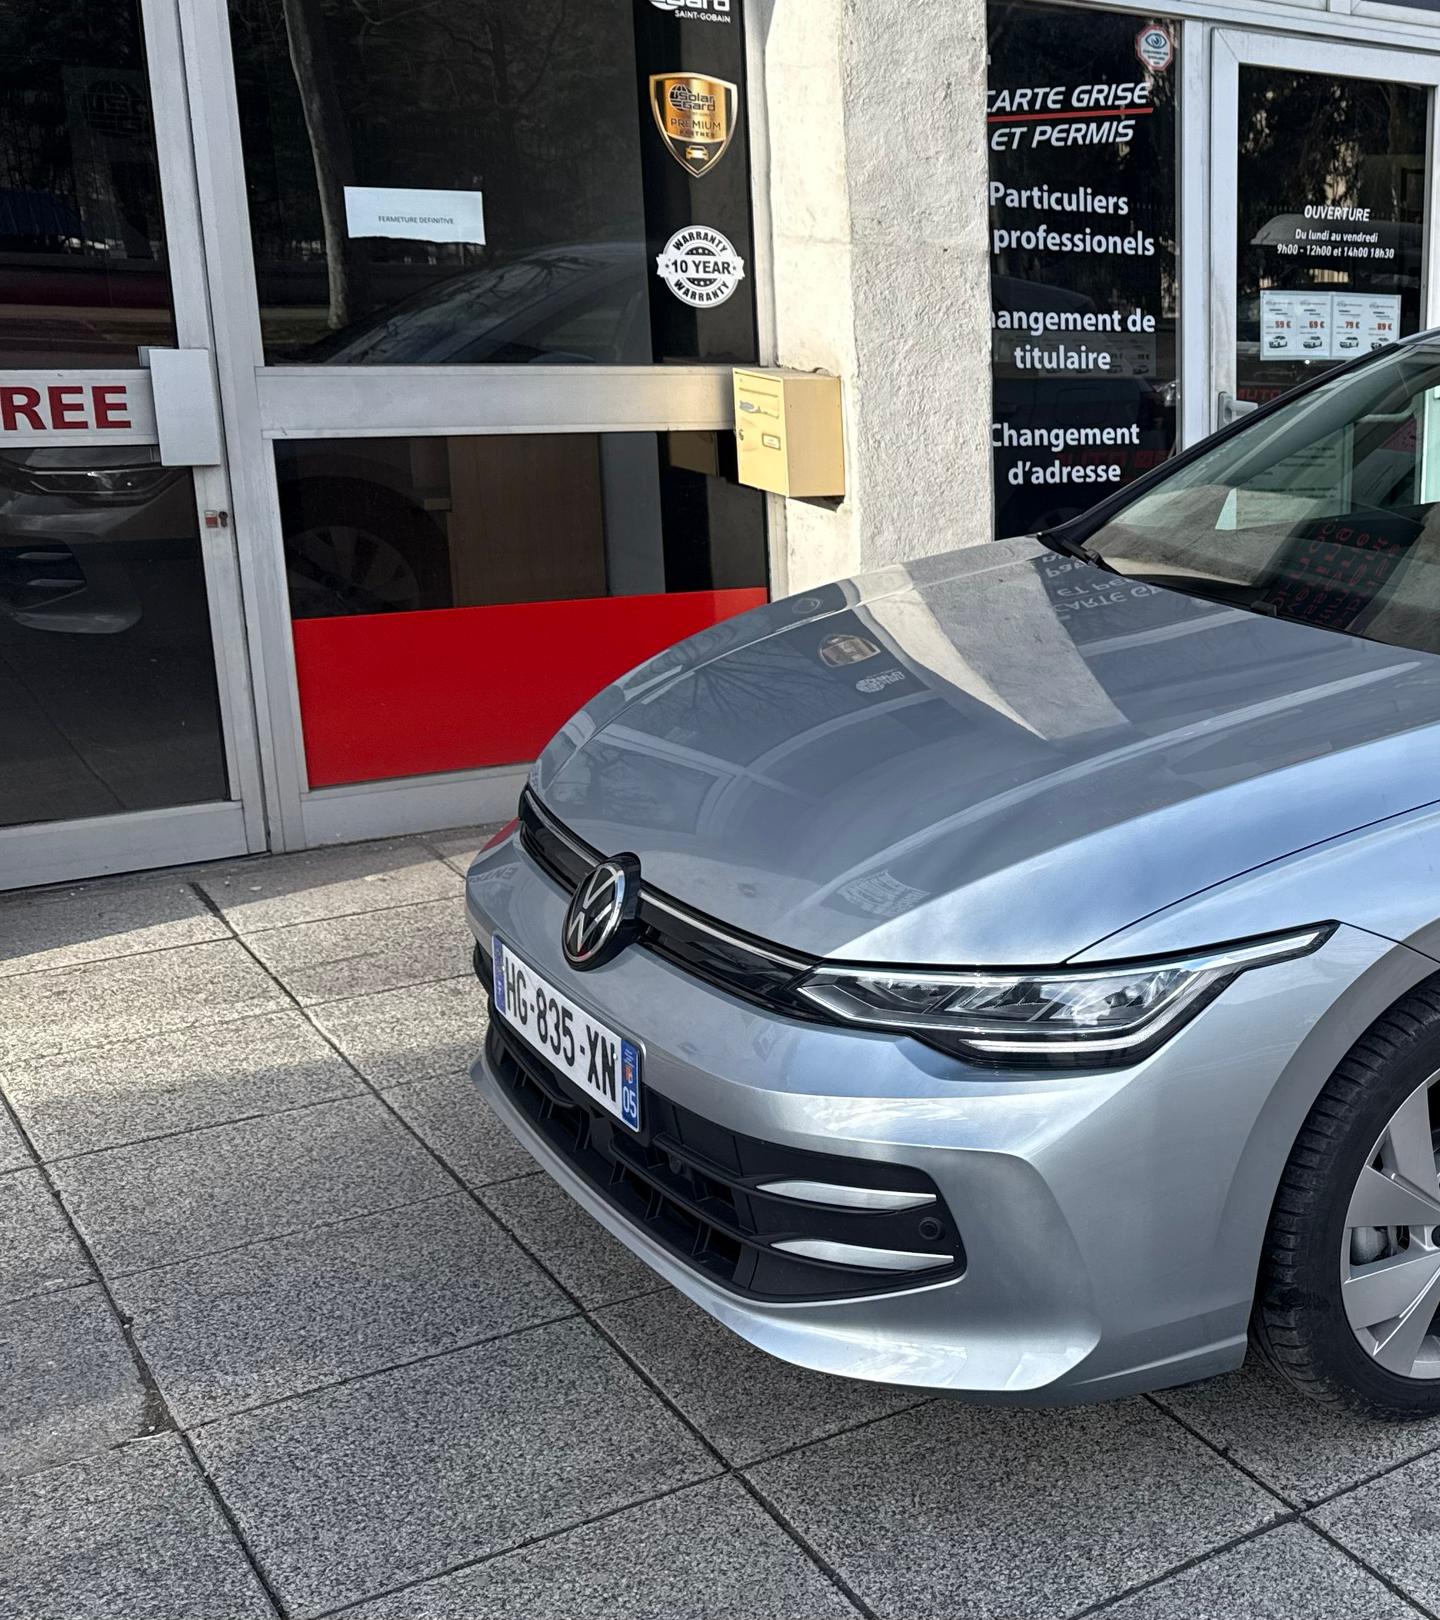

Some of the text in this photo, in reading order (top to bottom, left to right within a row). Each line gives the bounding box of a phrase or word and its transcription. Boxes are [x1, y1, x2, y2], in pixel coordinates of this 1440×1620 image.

[674, 9, 731, 23] SAINT-GOBAIN
[678, 92, 715, 104] Solar
[1070, 82, 1151, 109] GRISE
[670, 118, 721, 131] PREMIUM
[990, 119, 1136, 151] ET PERMIS
[989, 180, 1129, 216] Particuliers
[377, 215, 454, 225] FERMETURE DEFINITIVE
[1304, 204, 1371, 222] OUVERTURE
[672, 231, 728, 253] WARRANTY
[993, 224, 1156, 256] professionels
[1295, 228, 1379, 243] Du lundi au vendredi
[1276, 243, 1299, 255] 9h00
[1306, 245, 1332, 257] 12h00
[1332, 247, 1342, 257] et
[1343, 246, 1369, 258] 14h00
[1370, 247, 1395, 259] 18h30
[671, 259, 731, 275] 10 YEAR
[673, 279, 729, 302] WARRANTY
[1126, 308, 1156, 333] de
[1014, 344, 1112, 371] titulaire
[991, 422, 1140, 453] Changement
[504, 956, 618, 1104] HG-835-XN
[622, 1085, 637, 1119] 05
